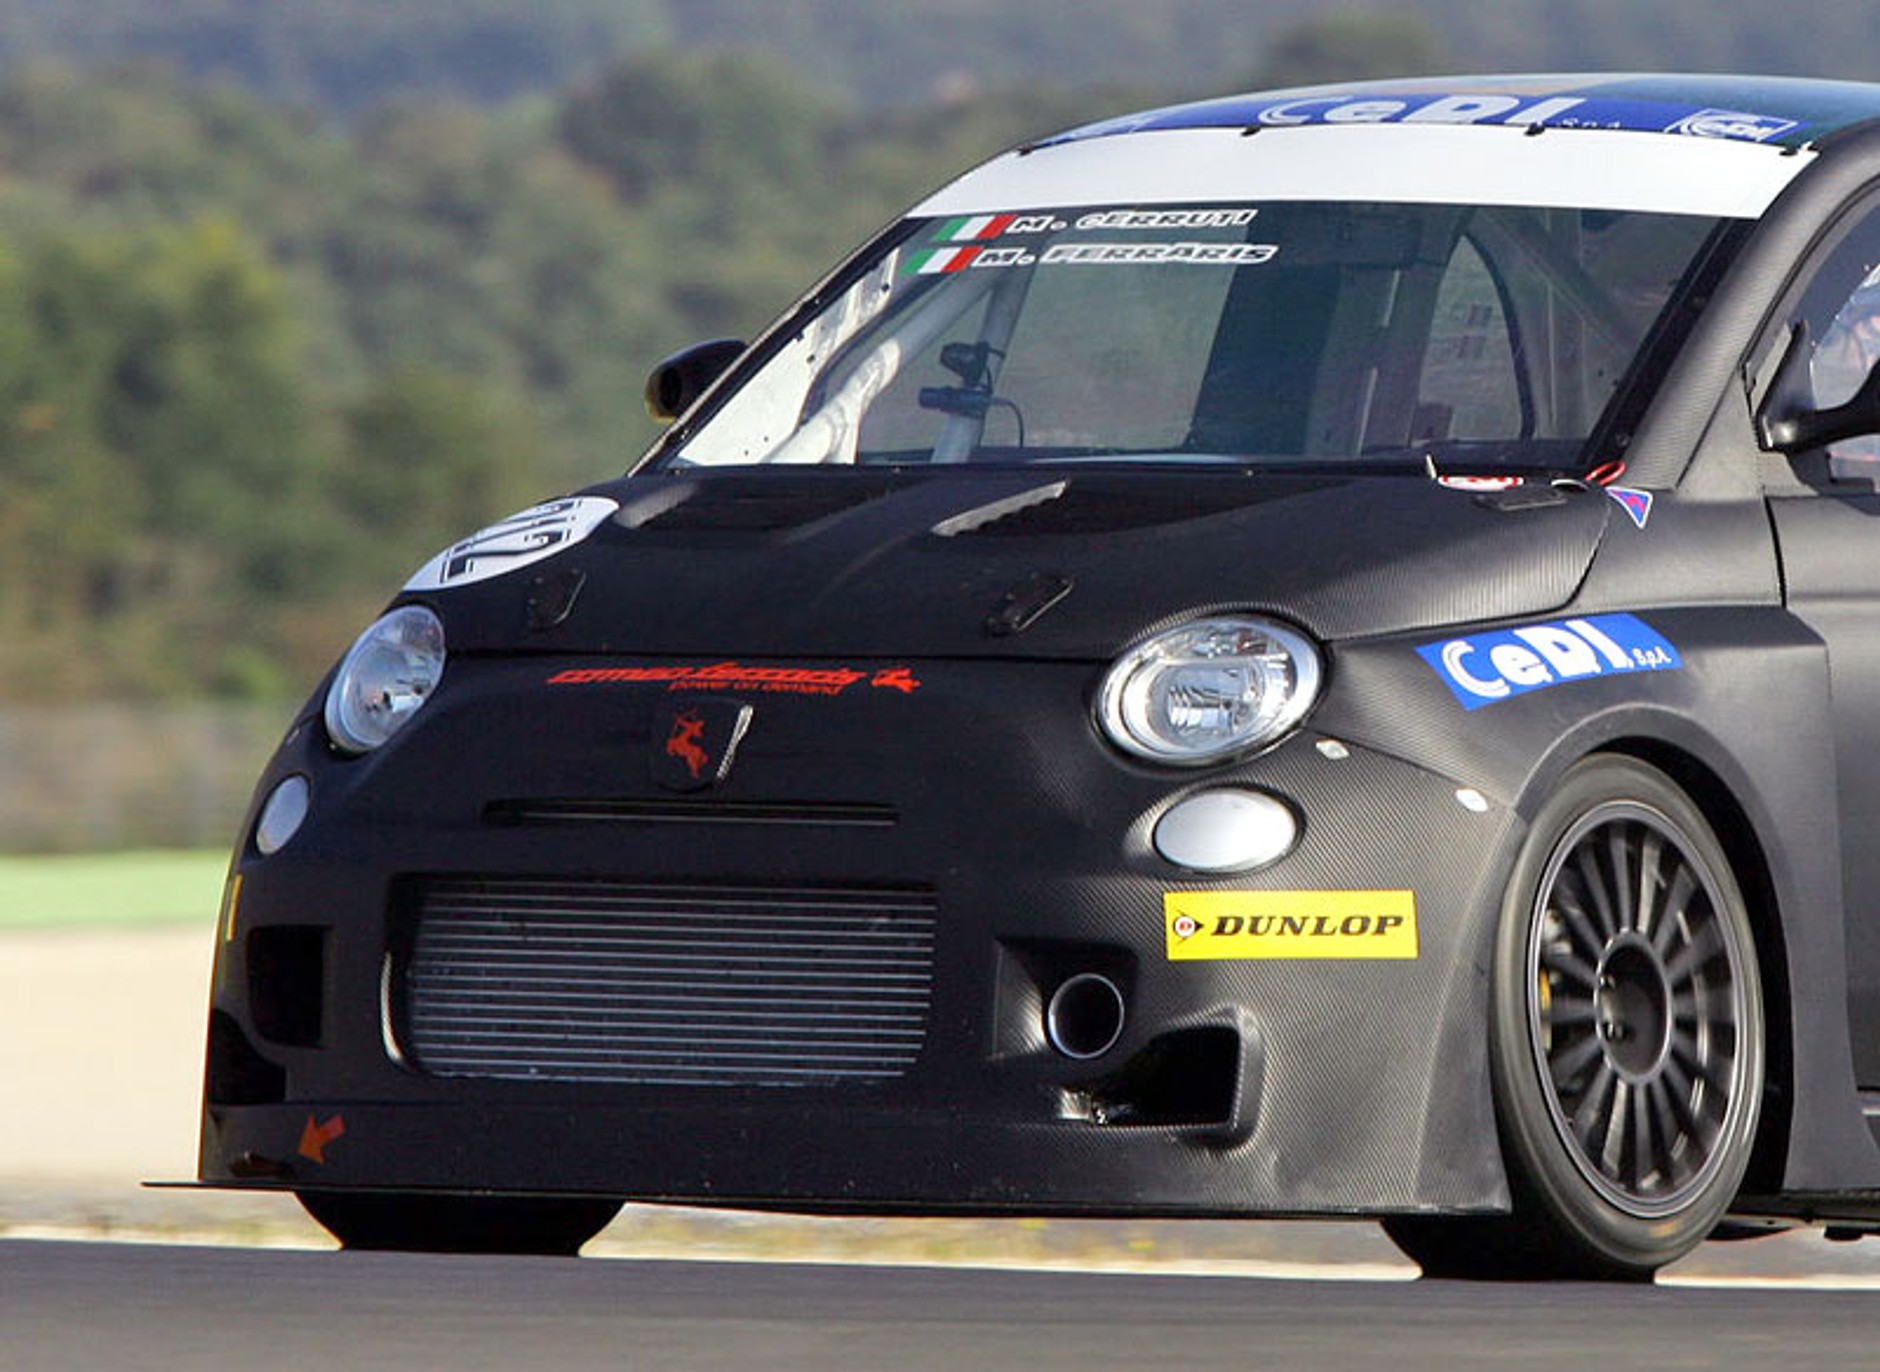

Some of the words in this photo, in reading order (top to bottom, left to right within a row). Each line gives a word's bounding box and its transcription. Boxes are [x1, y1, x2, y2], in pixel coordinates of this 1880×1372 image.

[1076, 209, 1258, 229] CERRUTI
[1040, 243, 1279, 264] FERRARIS
[1211, 915, 1405, 938] DUNLOP
